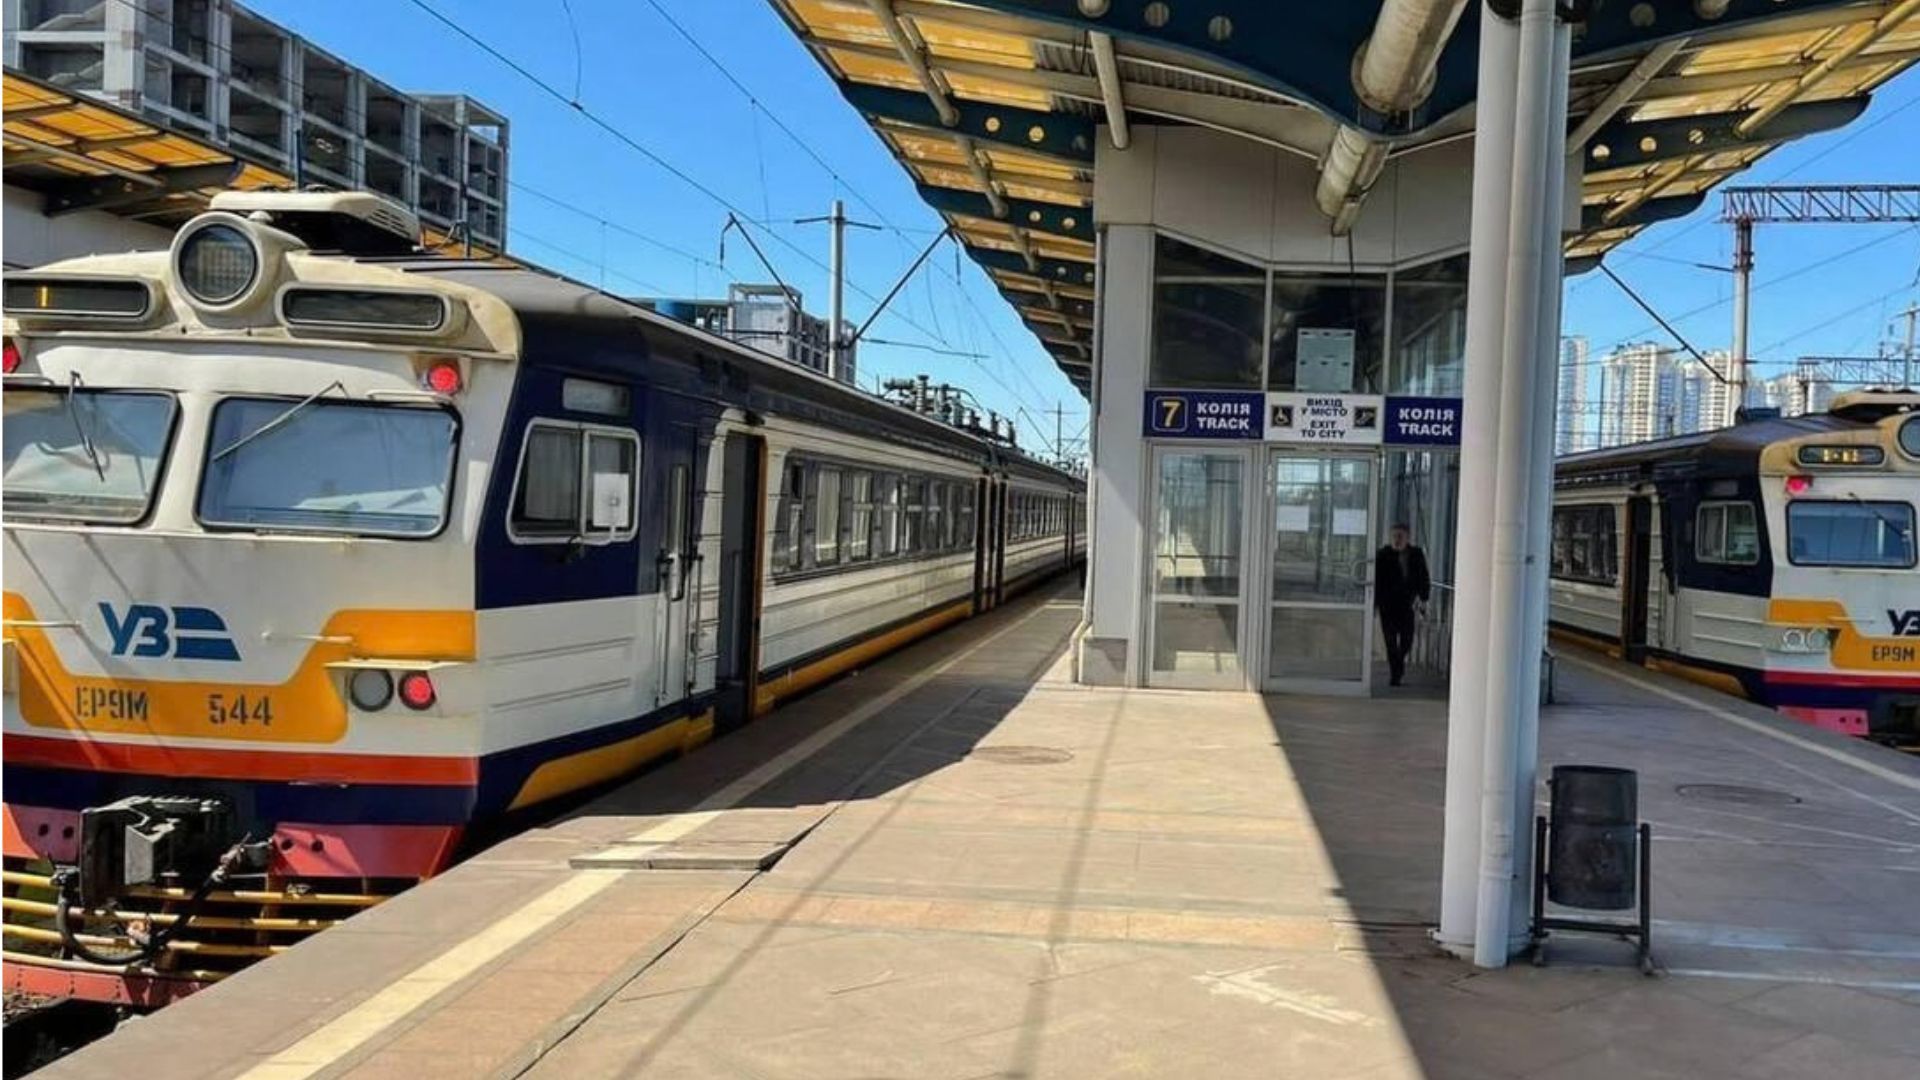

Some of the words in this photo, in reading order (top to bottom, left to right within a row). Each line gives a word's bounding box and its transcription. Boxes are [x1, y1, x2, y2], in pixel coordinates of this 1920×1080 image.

[1197, 402, 1251, 415] КОЛІЯ
[1306, 398, 1342, 407] ВИХІД
[1162, 401, 1180, 427] 7
[1311, 408, 1348, 416] МІСТО
[1399, 408, 1454, 421] КОЛІЯ
[1196, 416, 1250, 430] TRACK
[1310, 420, 1336, 429] EXIT
[1398, 422, 1453, 436] TRACK
[1301, 430, 1316, 438] TO
[1319, 430, 1345, 439] CITY
[76, 686, 149, 721] ЕР9М
[207, 693, 273, 726] 544
